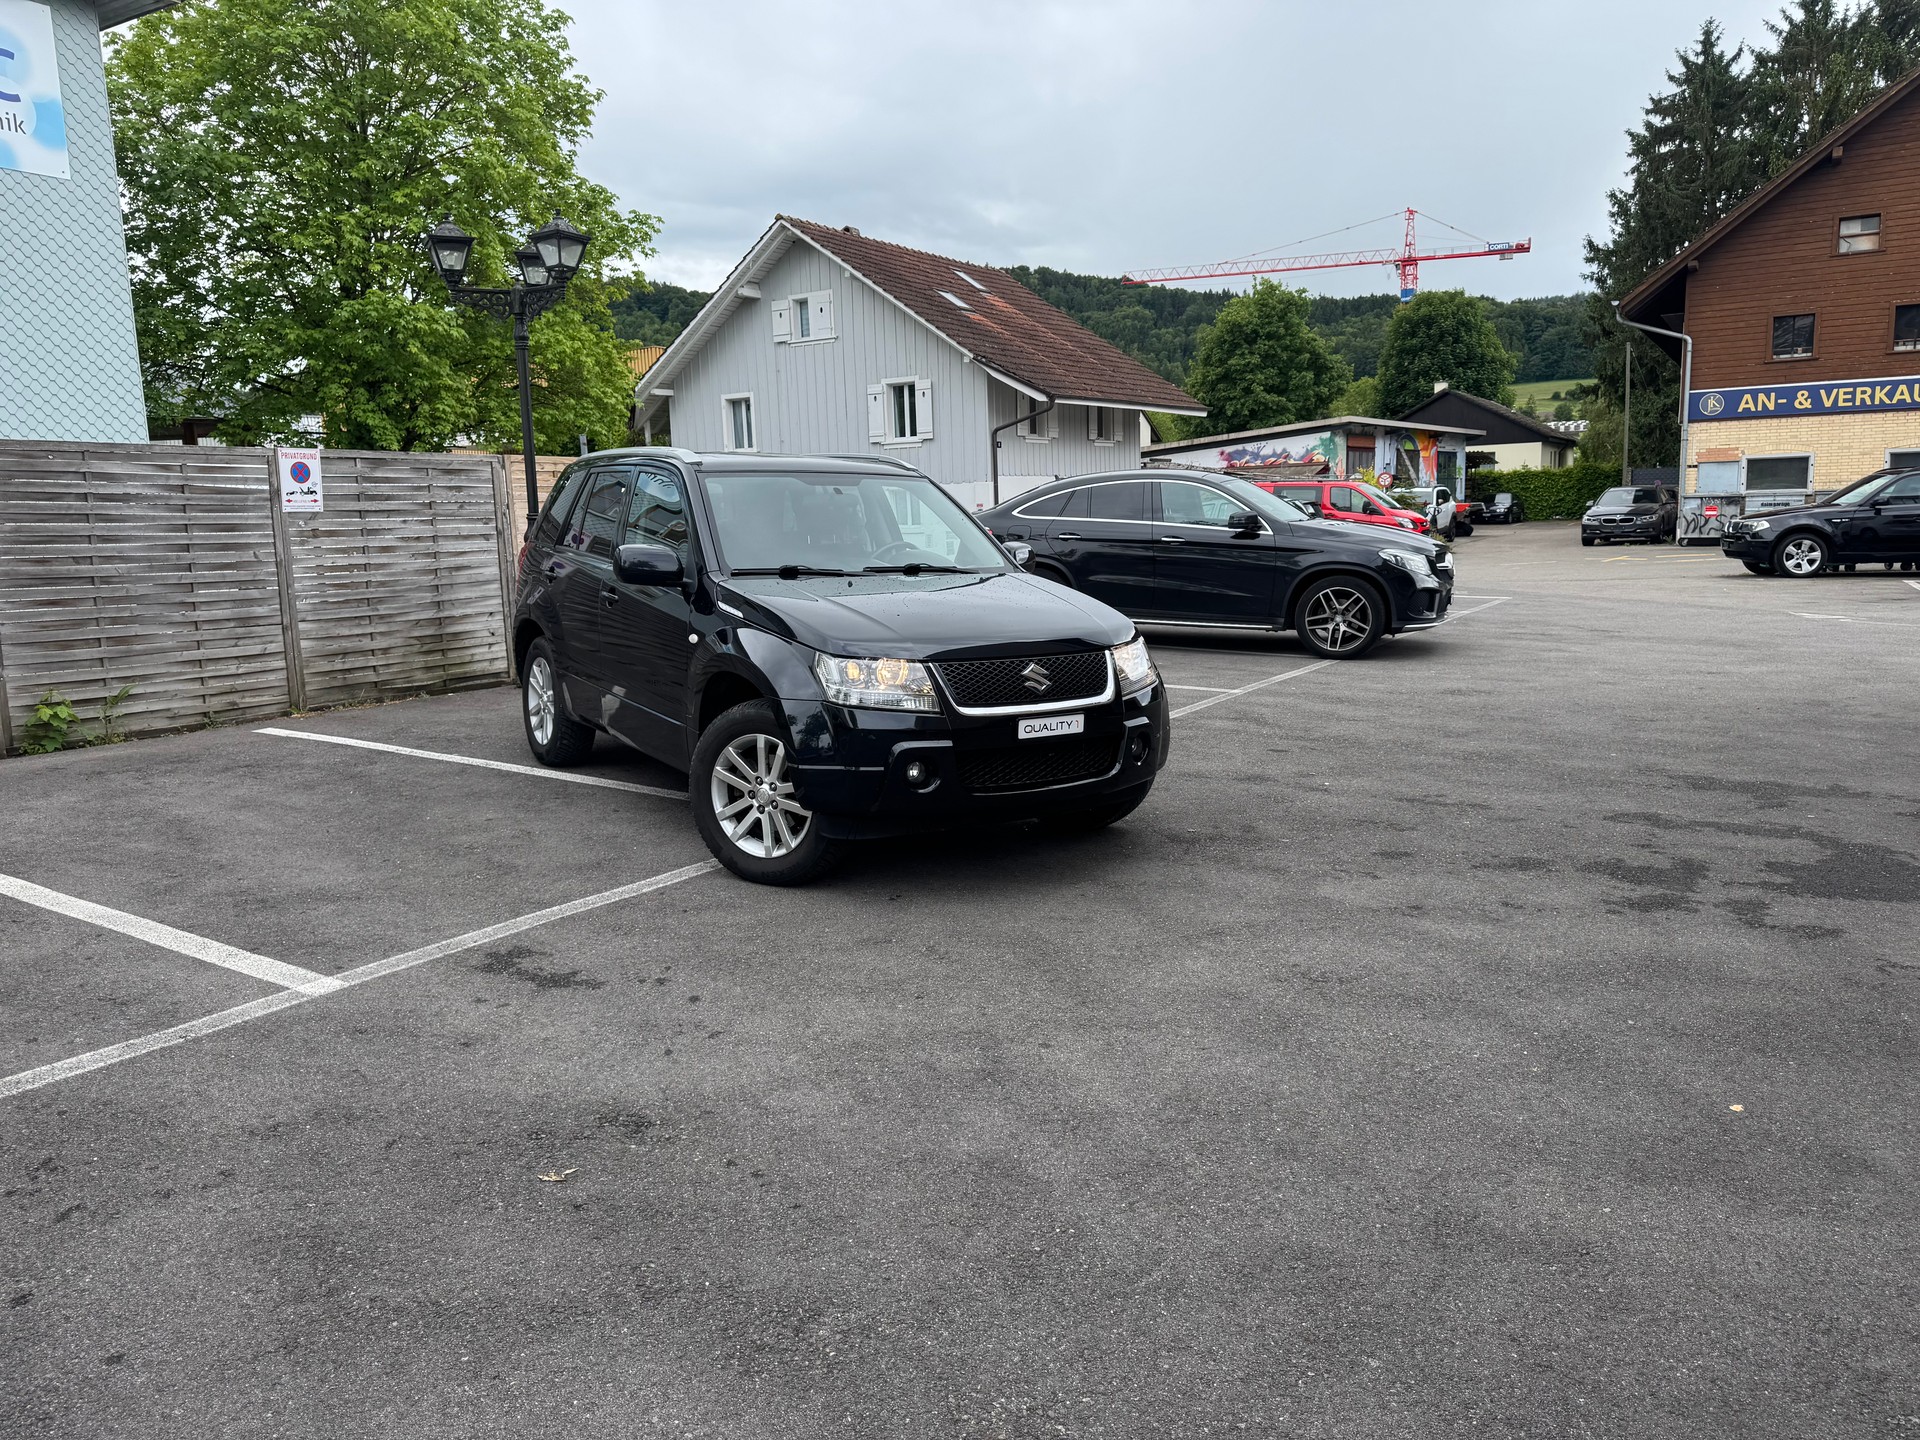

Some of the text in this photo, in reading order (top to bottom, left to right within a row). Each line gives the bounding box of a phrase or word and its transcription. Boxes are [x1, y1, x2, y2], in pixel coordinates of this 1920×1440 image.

[1737, 392, 1787, 412] AN-
[1794, 390, 1812, 409] &
[281, 452, 318, 460] PRIVATGRUND
[1024, 720, 1079, 734] QUALITY 1
